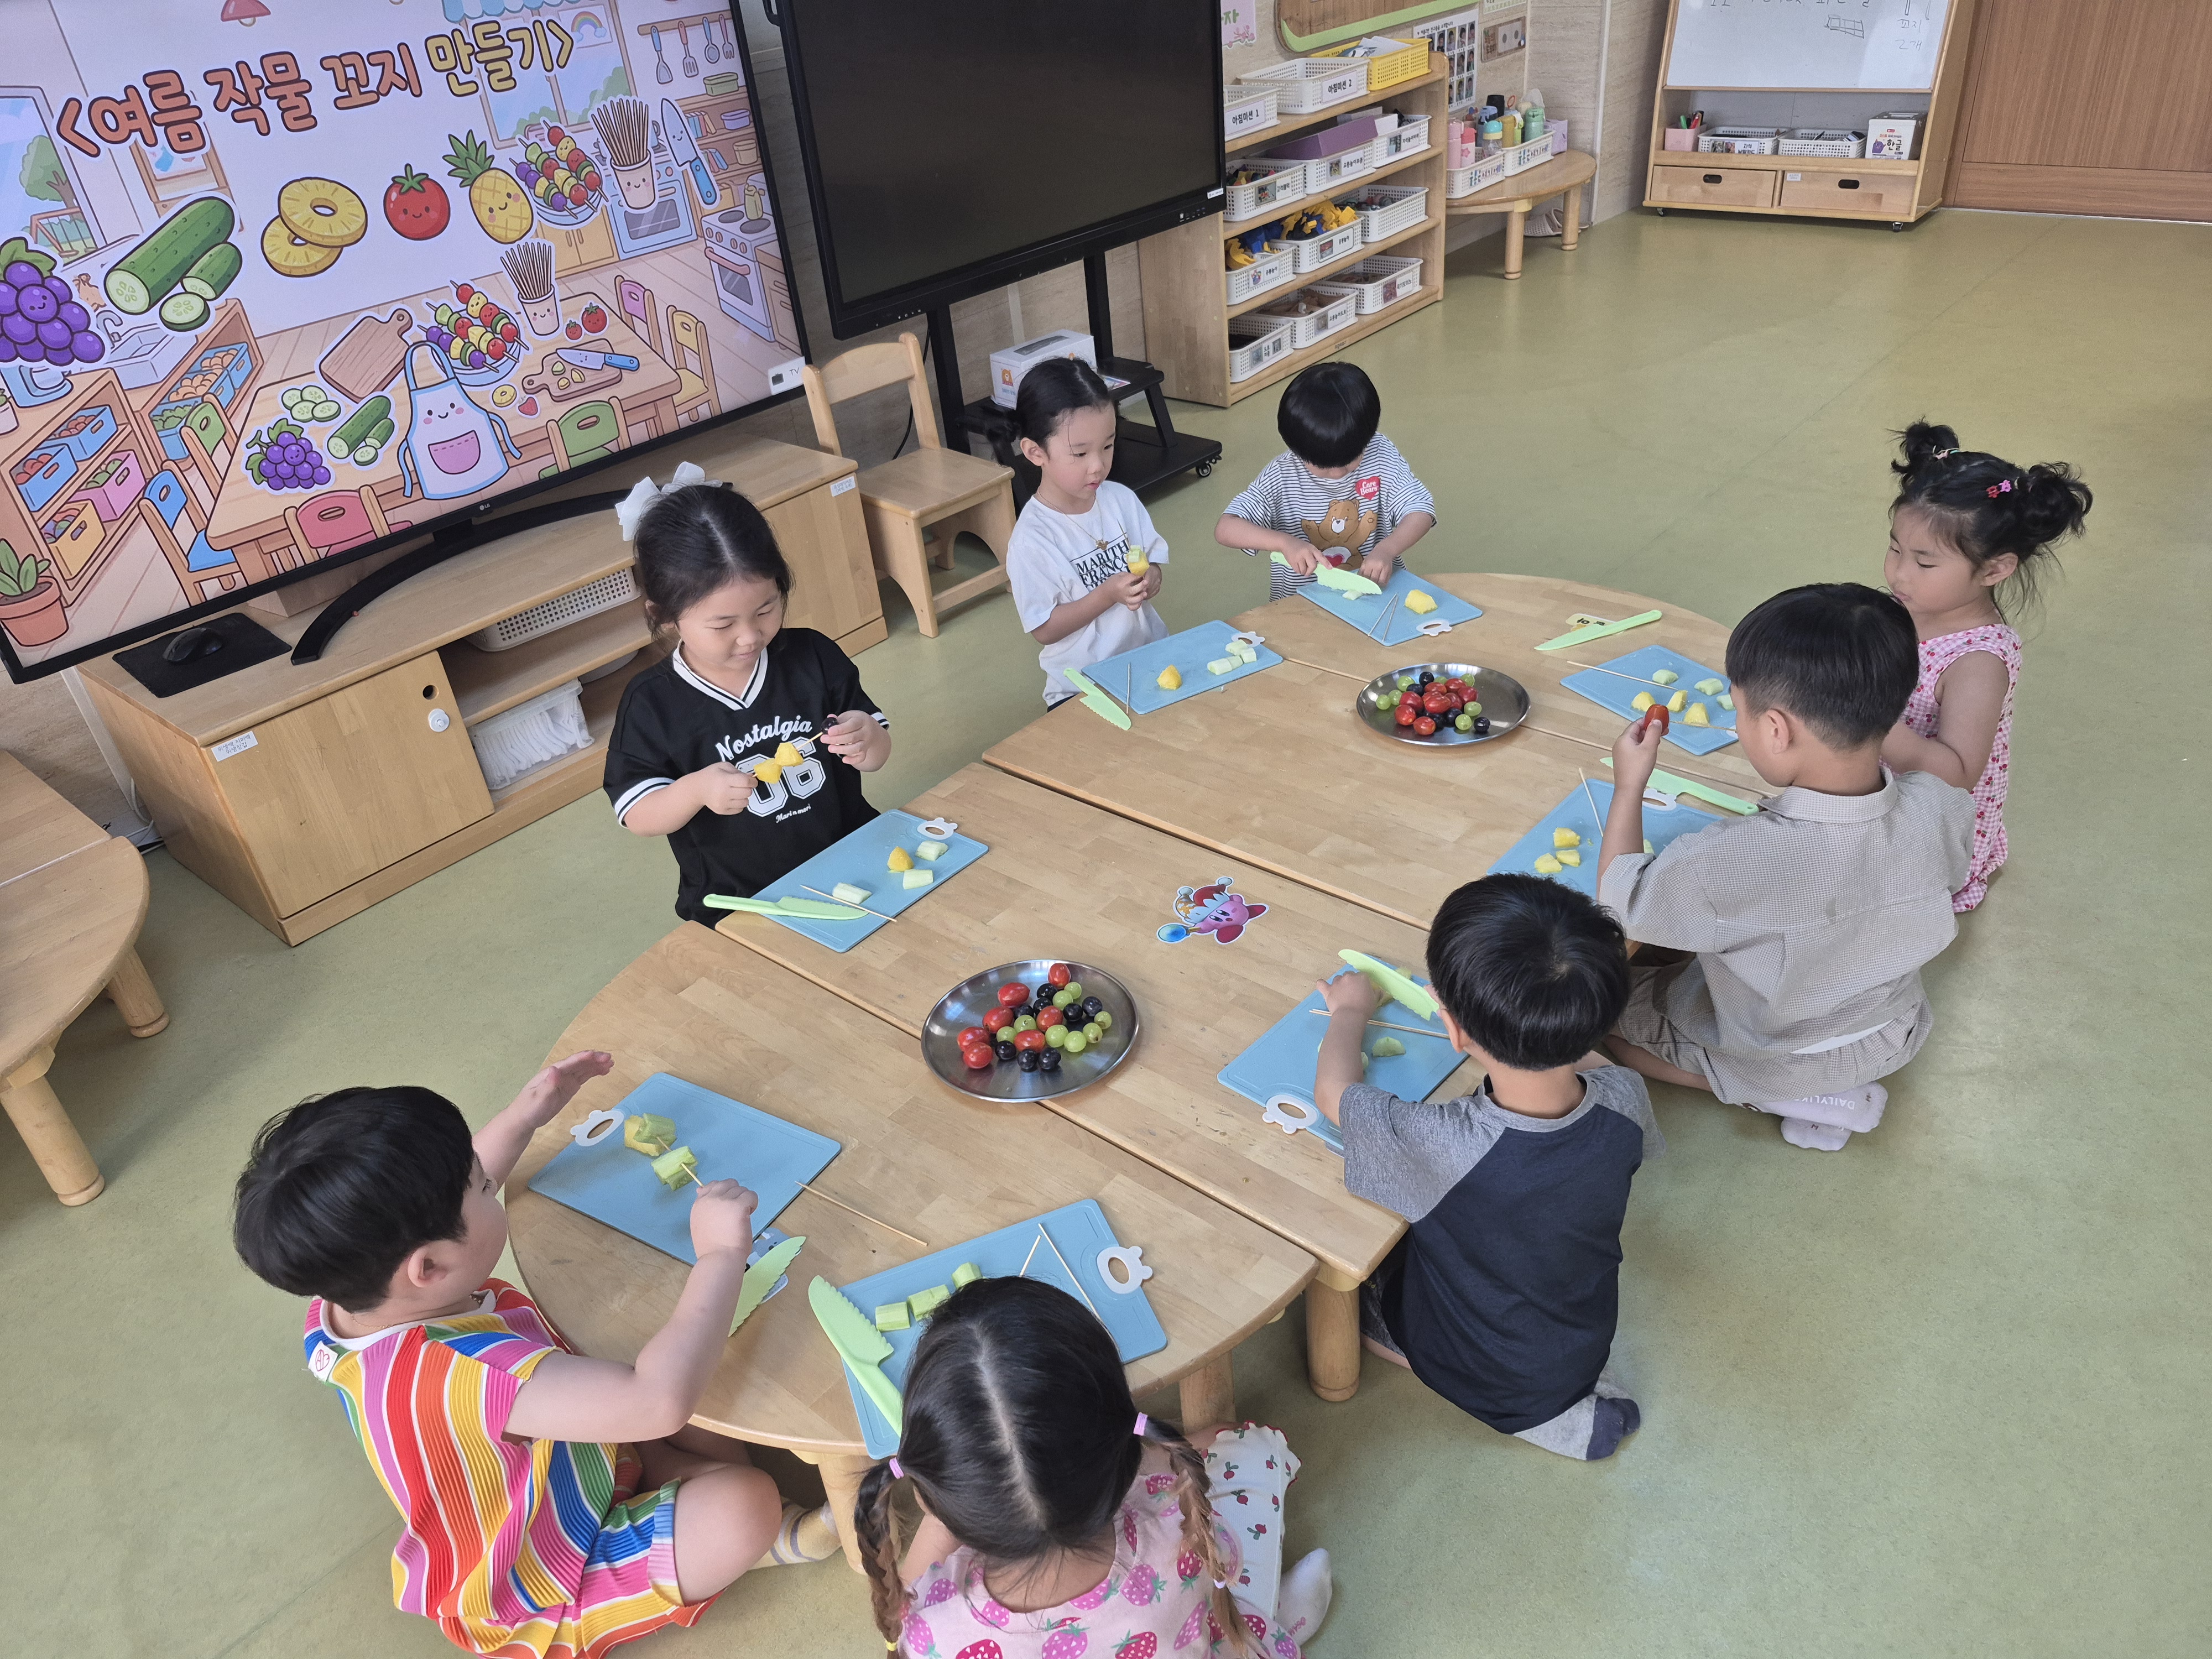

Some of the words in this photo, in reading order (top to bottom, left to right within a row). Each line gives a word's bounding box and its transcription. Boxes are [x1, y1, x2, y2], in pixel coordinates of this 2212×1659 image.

[56, 70, 206, 158] <여름
[203, 51, 317, 136] 작물
[320, 43, 422, 110] 꼬지
[425, 19, 573, 97] 만들기>
[1328, 80, 1347, 93] 아침미션
[1232, 111, 1253, 126] 아침미션
[1887, 139, 1902, 150] 한글
[789, 367, 799, 376] TV
[1360, 487, 1378, 495] Bears
[1076, 539, 1130, 575] MARITH
[715, 715, 813, 761] Nostalgia
[1795, 1095, 1855, 1110] DAILYLIK
